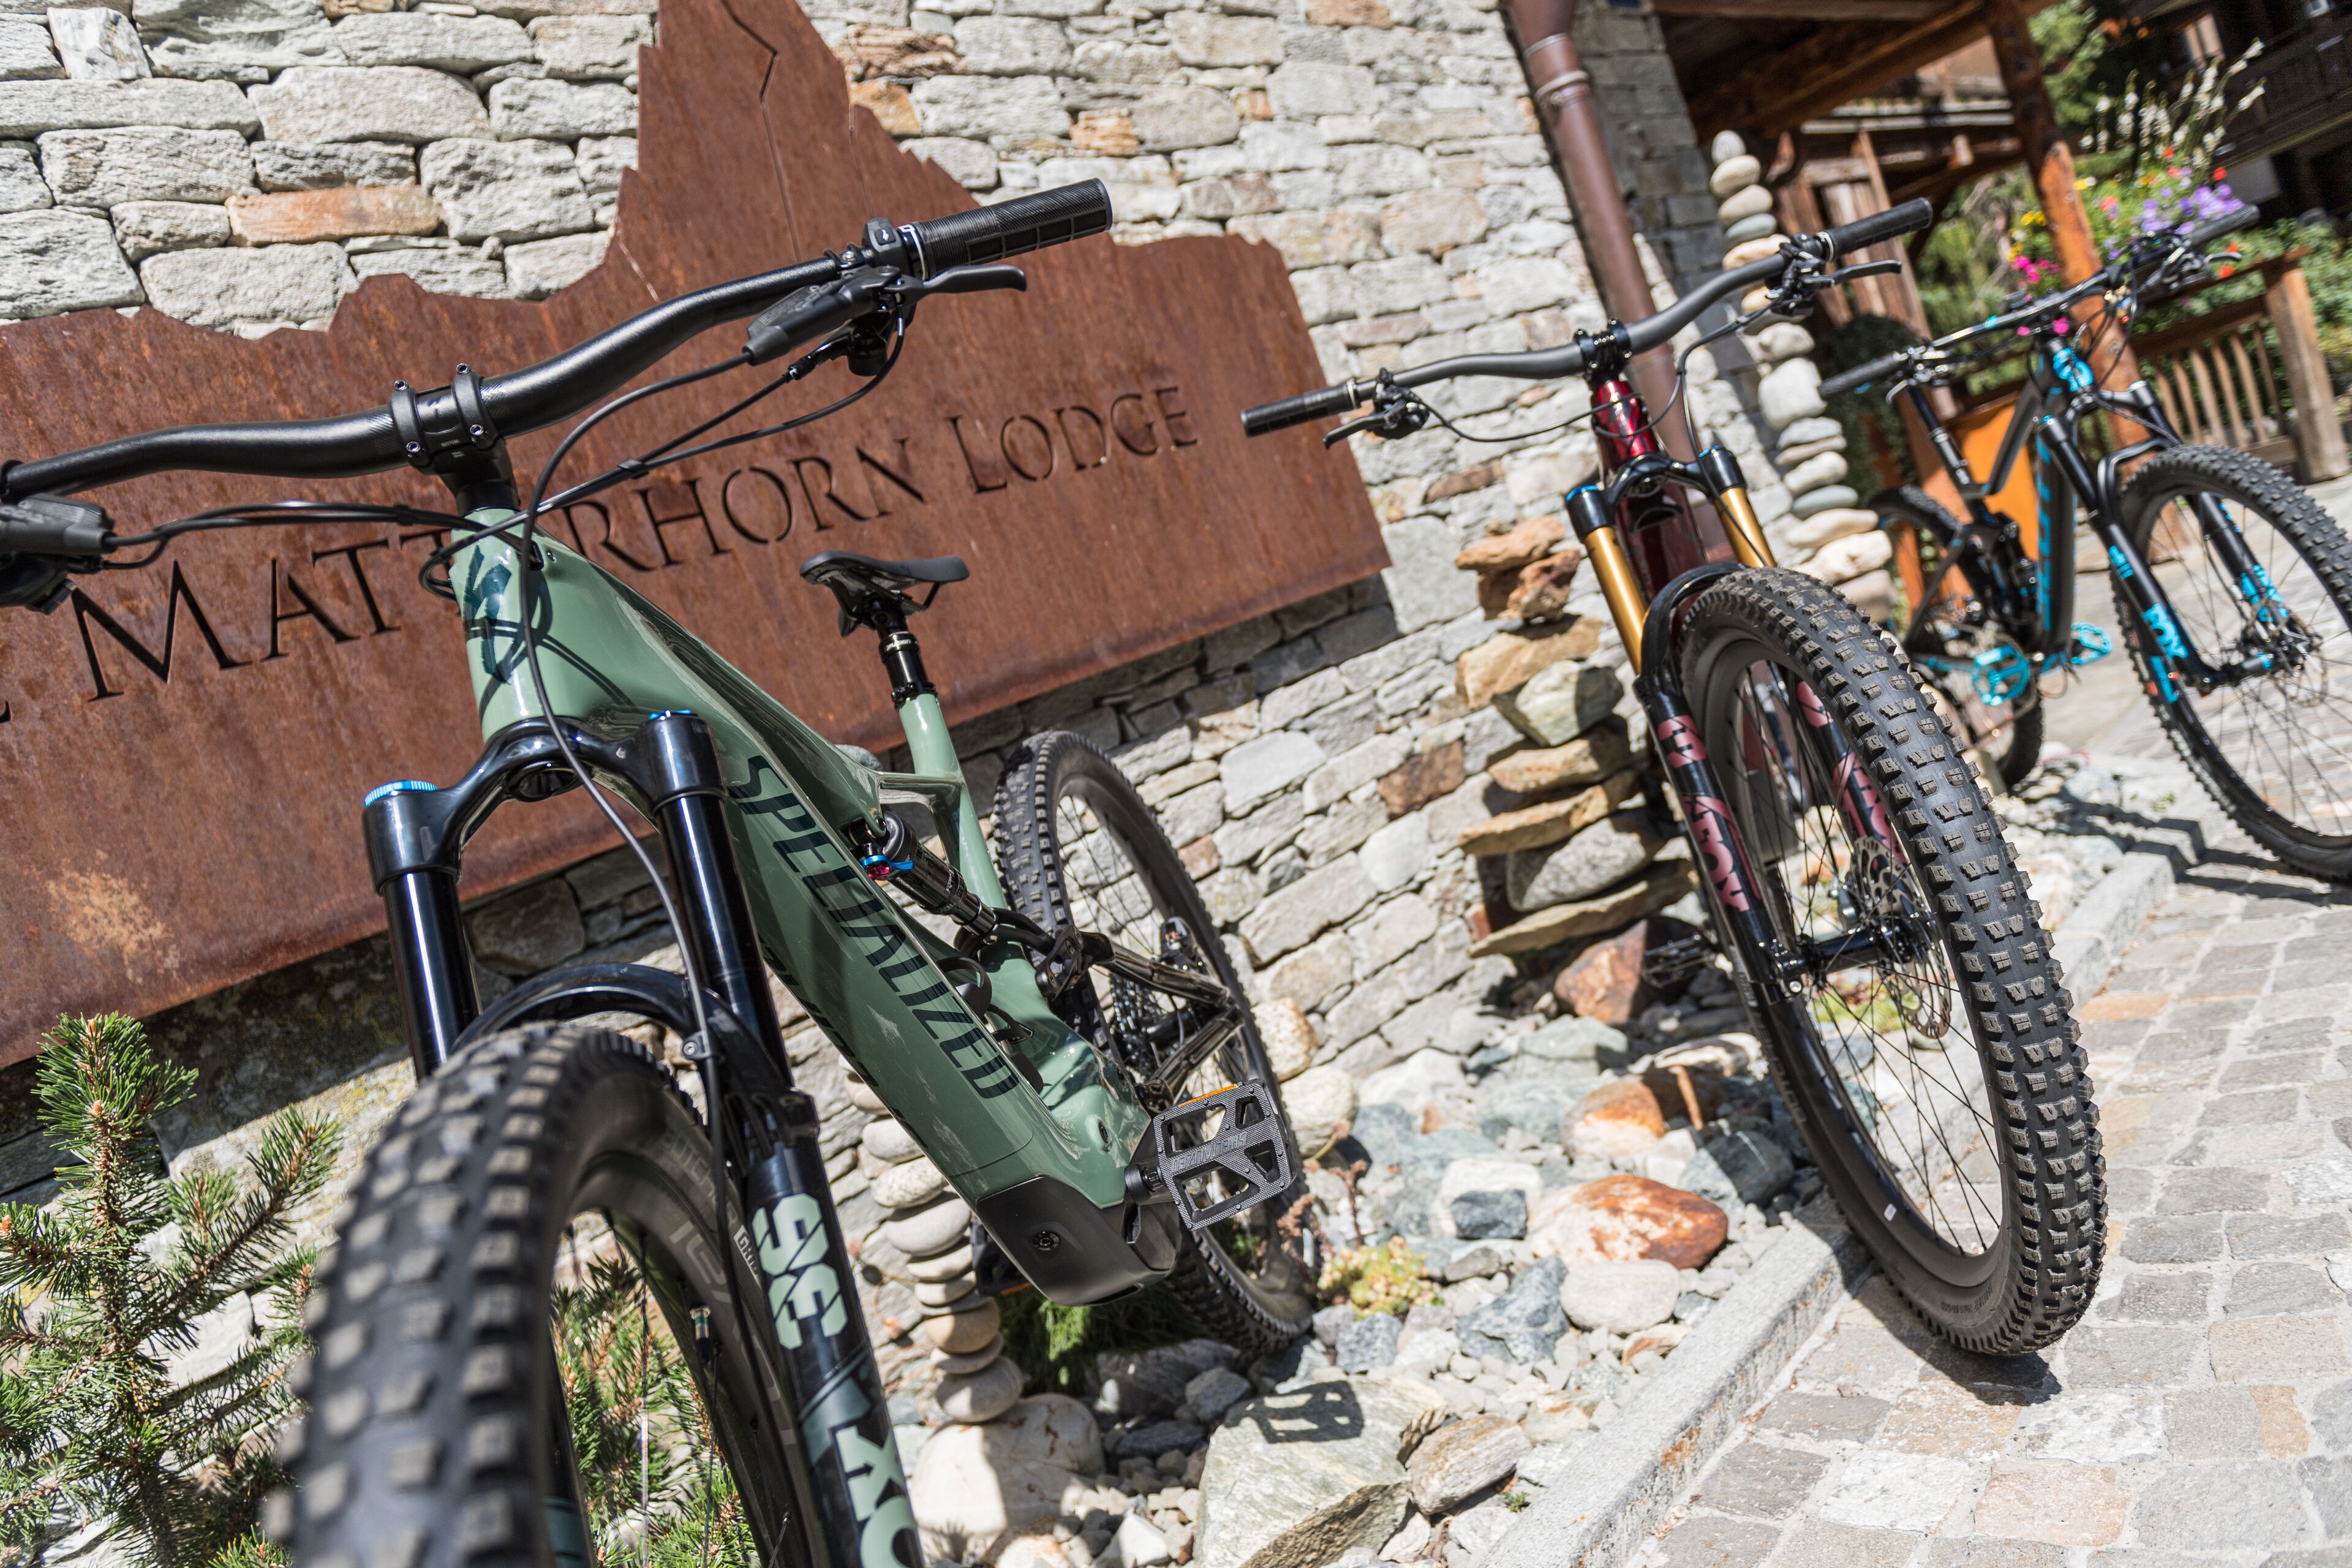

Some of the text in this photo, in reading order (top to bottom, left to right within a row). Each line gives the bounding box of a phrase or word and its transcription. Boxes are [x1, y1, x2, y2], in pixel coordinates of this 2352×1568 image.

[71, 386, 1198, 702] MATTRHORN LODGE
[729, 755, 1021, 1101] SPECIALIZED
[1171, 1133, 1248, 1173] SPECIALIZED
[752, 1193, 848, 1350] 36
